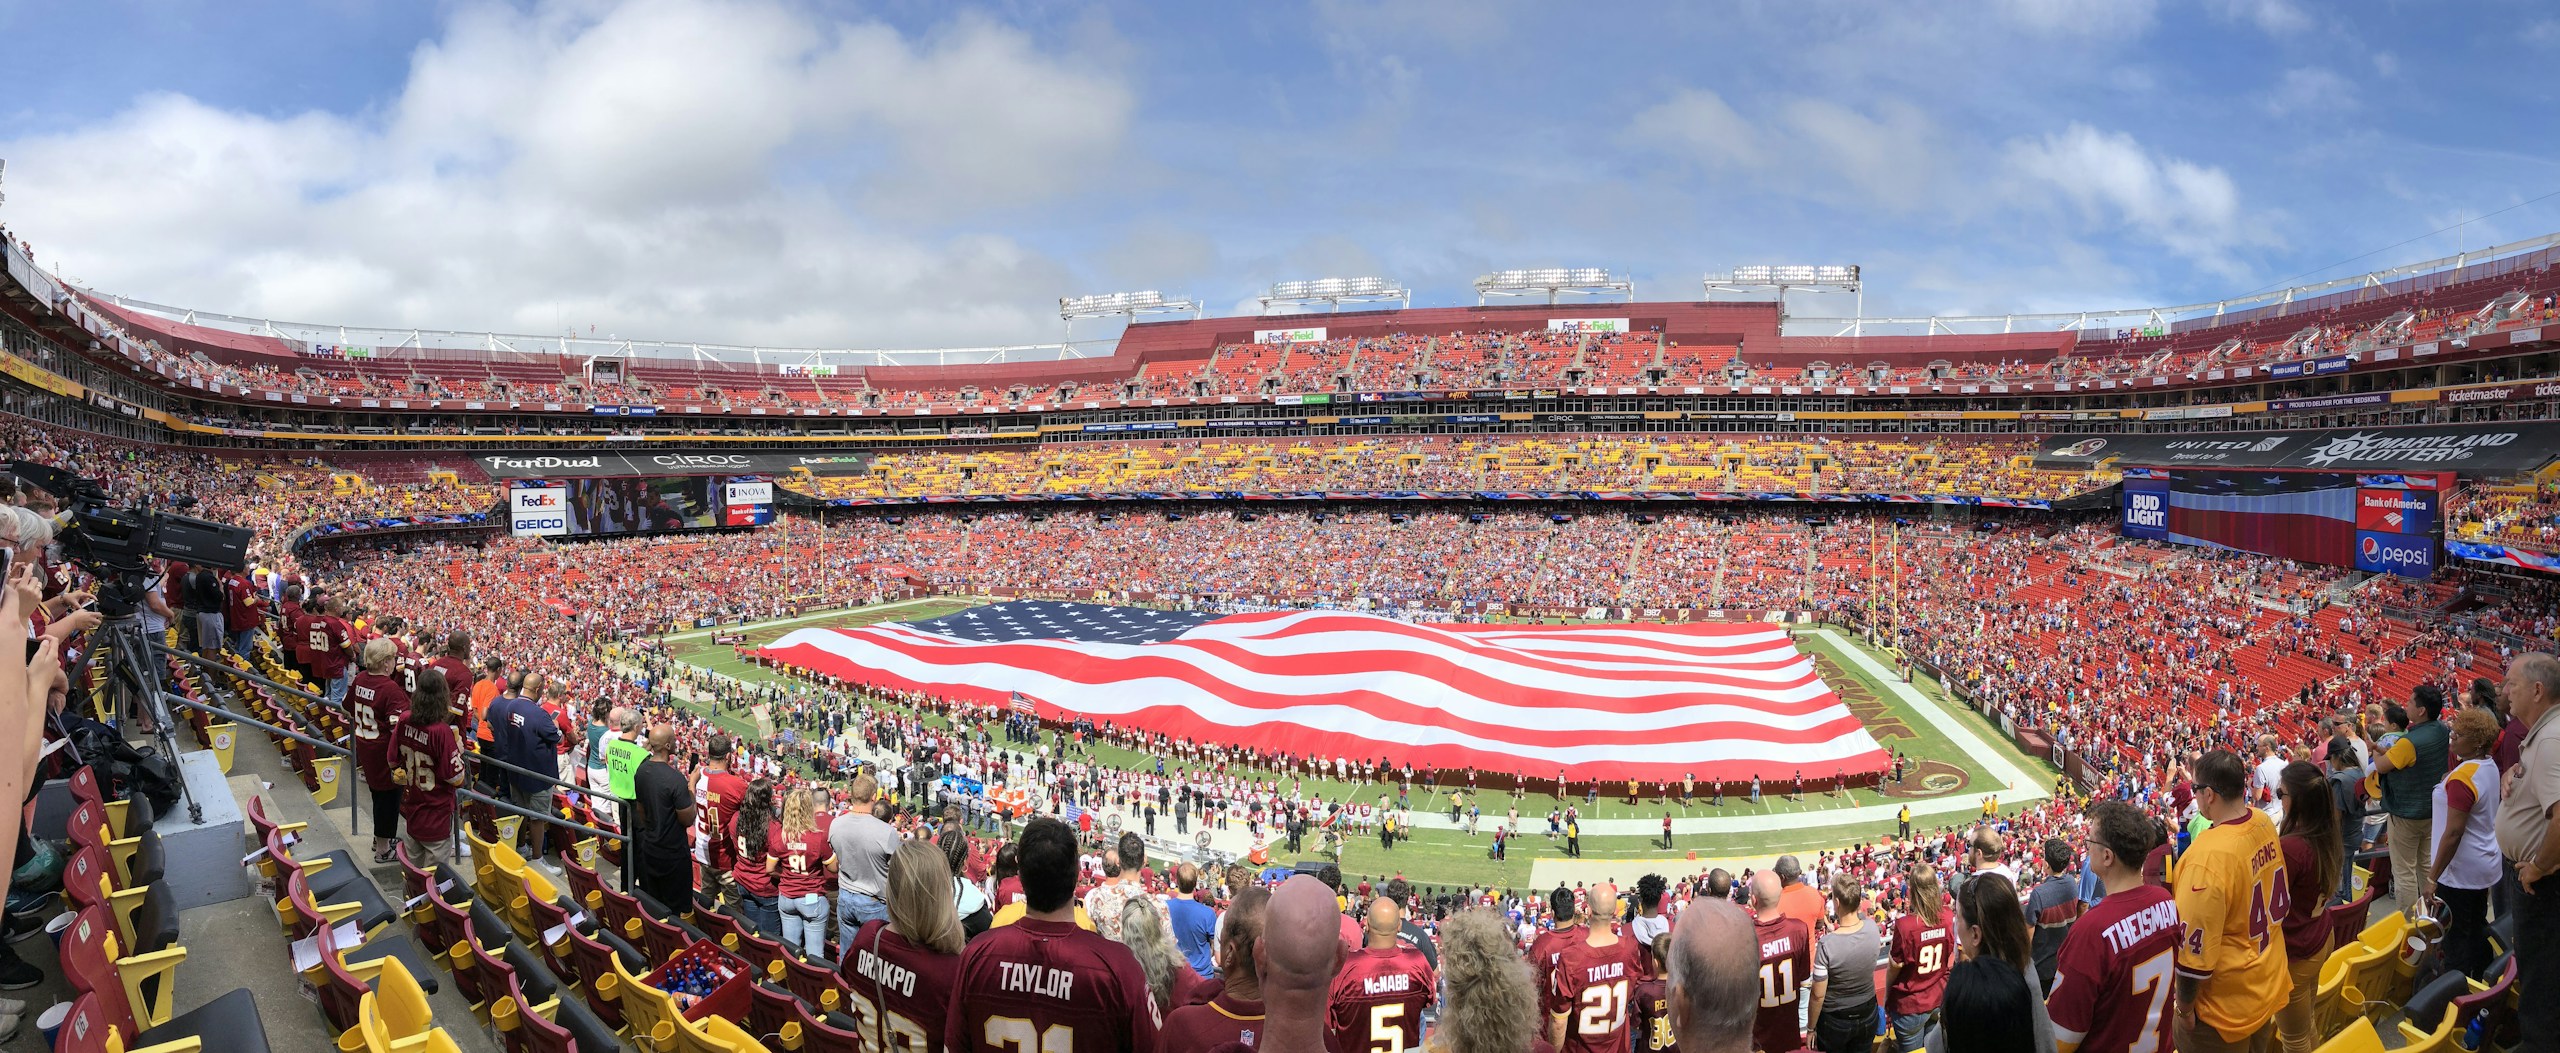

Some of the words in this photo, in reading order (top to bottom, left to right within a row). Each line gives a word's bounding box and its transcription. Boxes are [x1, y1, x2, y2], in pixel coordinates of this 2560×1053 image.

[1562, 320, 1615, 331] FedExField
[2118, 326, 2164, 339] FedExField
[1268, 330, 1314, 341] FedExField
[316, 344, 368, 358] FedExField
[786, 366, 831, 375] FedExField
[1360, 393, 1382, 402] FedEx
[2449, 388, 2510, 402] ticketmaster
[2166, 441, 2252, 450] UNITED
[2376, 432, 2518, 449] MARYLAND
[2352, 446, 2472, 462] LOTTERY
[485, 456, 601, 470] FanDuel
[738, 488, 765, 496] INOVA
[522, 494, 556, 507] FedEx
[2132, 494, 2160, 510] BUD
[2365, 496, 2384, 506] Bank
[2384, 498, 2392, 508] of
[2393, 498, 2426, 510] America
[515, 519, 563, 530] GEICO
[2128, 509, 2164, 527] LIGHT
[162, 542, 185, 551] DIGISUPER
[2382, 546, 2427, 566] pepsi
[508, 712, 524, 726] USA
[404, 724, 428, 745] TAYLOR
[609, 746, 631, 760] VENDOR
[398, 744, 436, 792] 36
[612, 759, 628, 774] 1034
[1261, 850, 1266, 859] G
[788, 854, 809, 876] 91
[2249, 866, 2290, 956] 44
[1921, 928, 1946, 942] KERRIGAN
[1762, 936, 1791, 958] SMITH
[1918, 943, 1943, 974] 91
[858, 948, 916, 998] ORAKPO
[999, 961, 1074, 1000] TAYLOR
[1587, 962, 1623, 983] TAYLOR
[1364, 974, 1409, 994] McNABB
[1760, 958, 1796, 1008] 11
[1578, 979, 1628, 1035] 21
[2132, 946, 2174, 1053] 7
[77, 1016, 85, 1035] 16
[1370, 1003, 1404, 1053] 5
